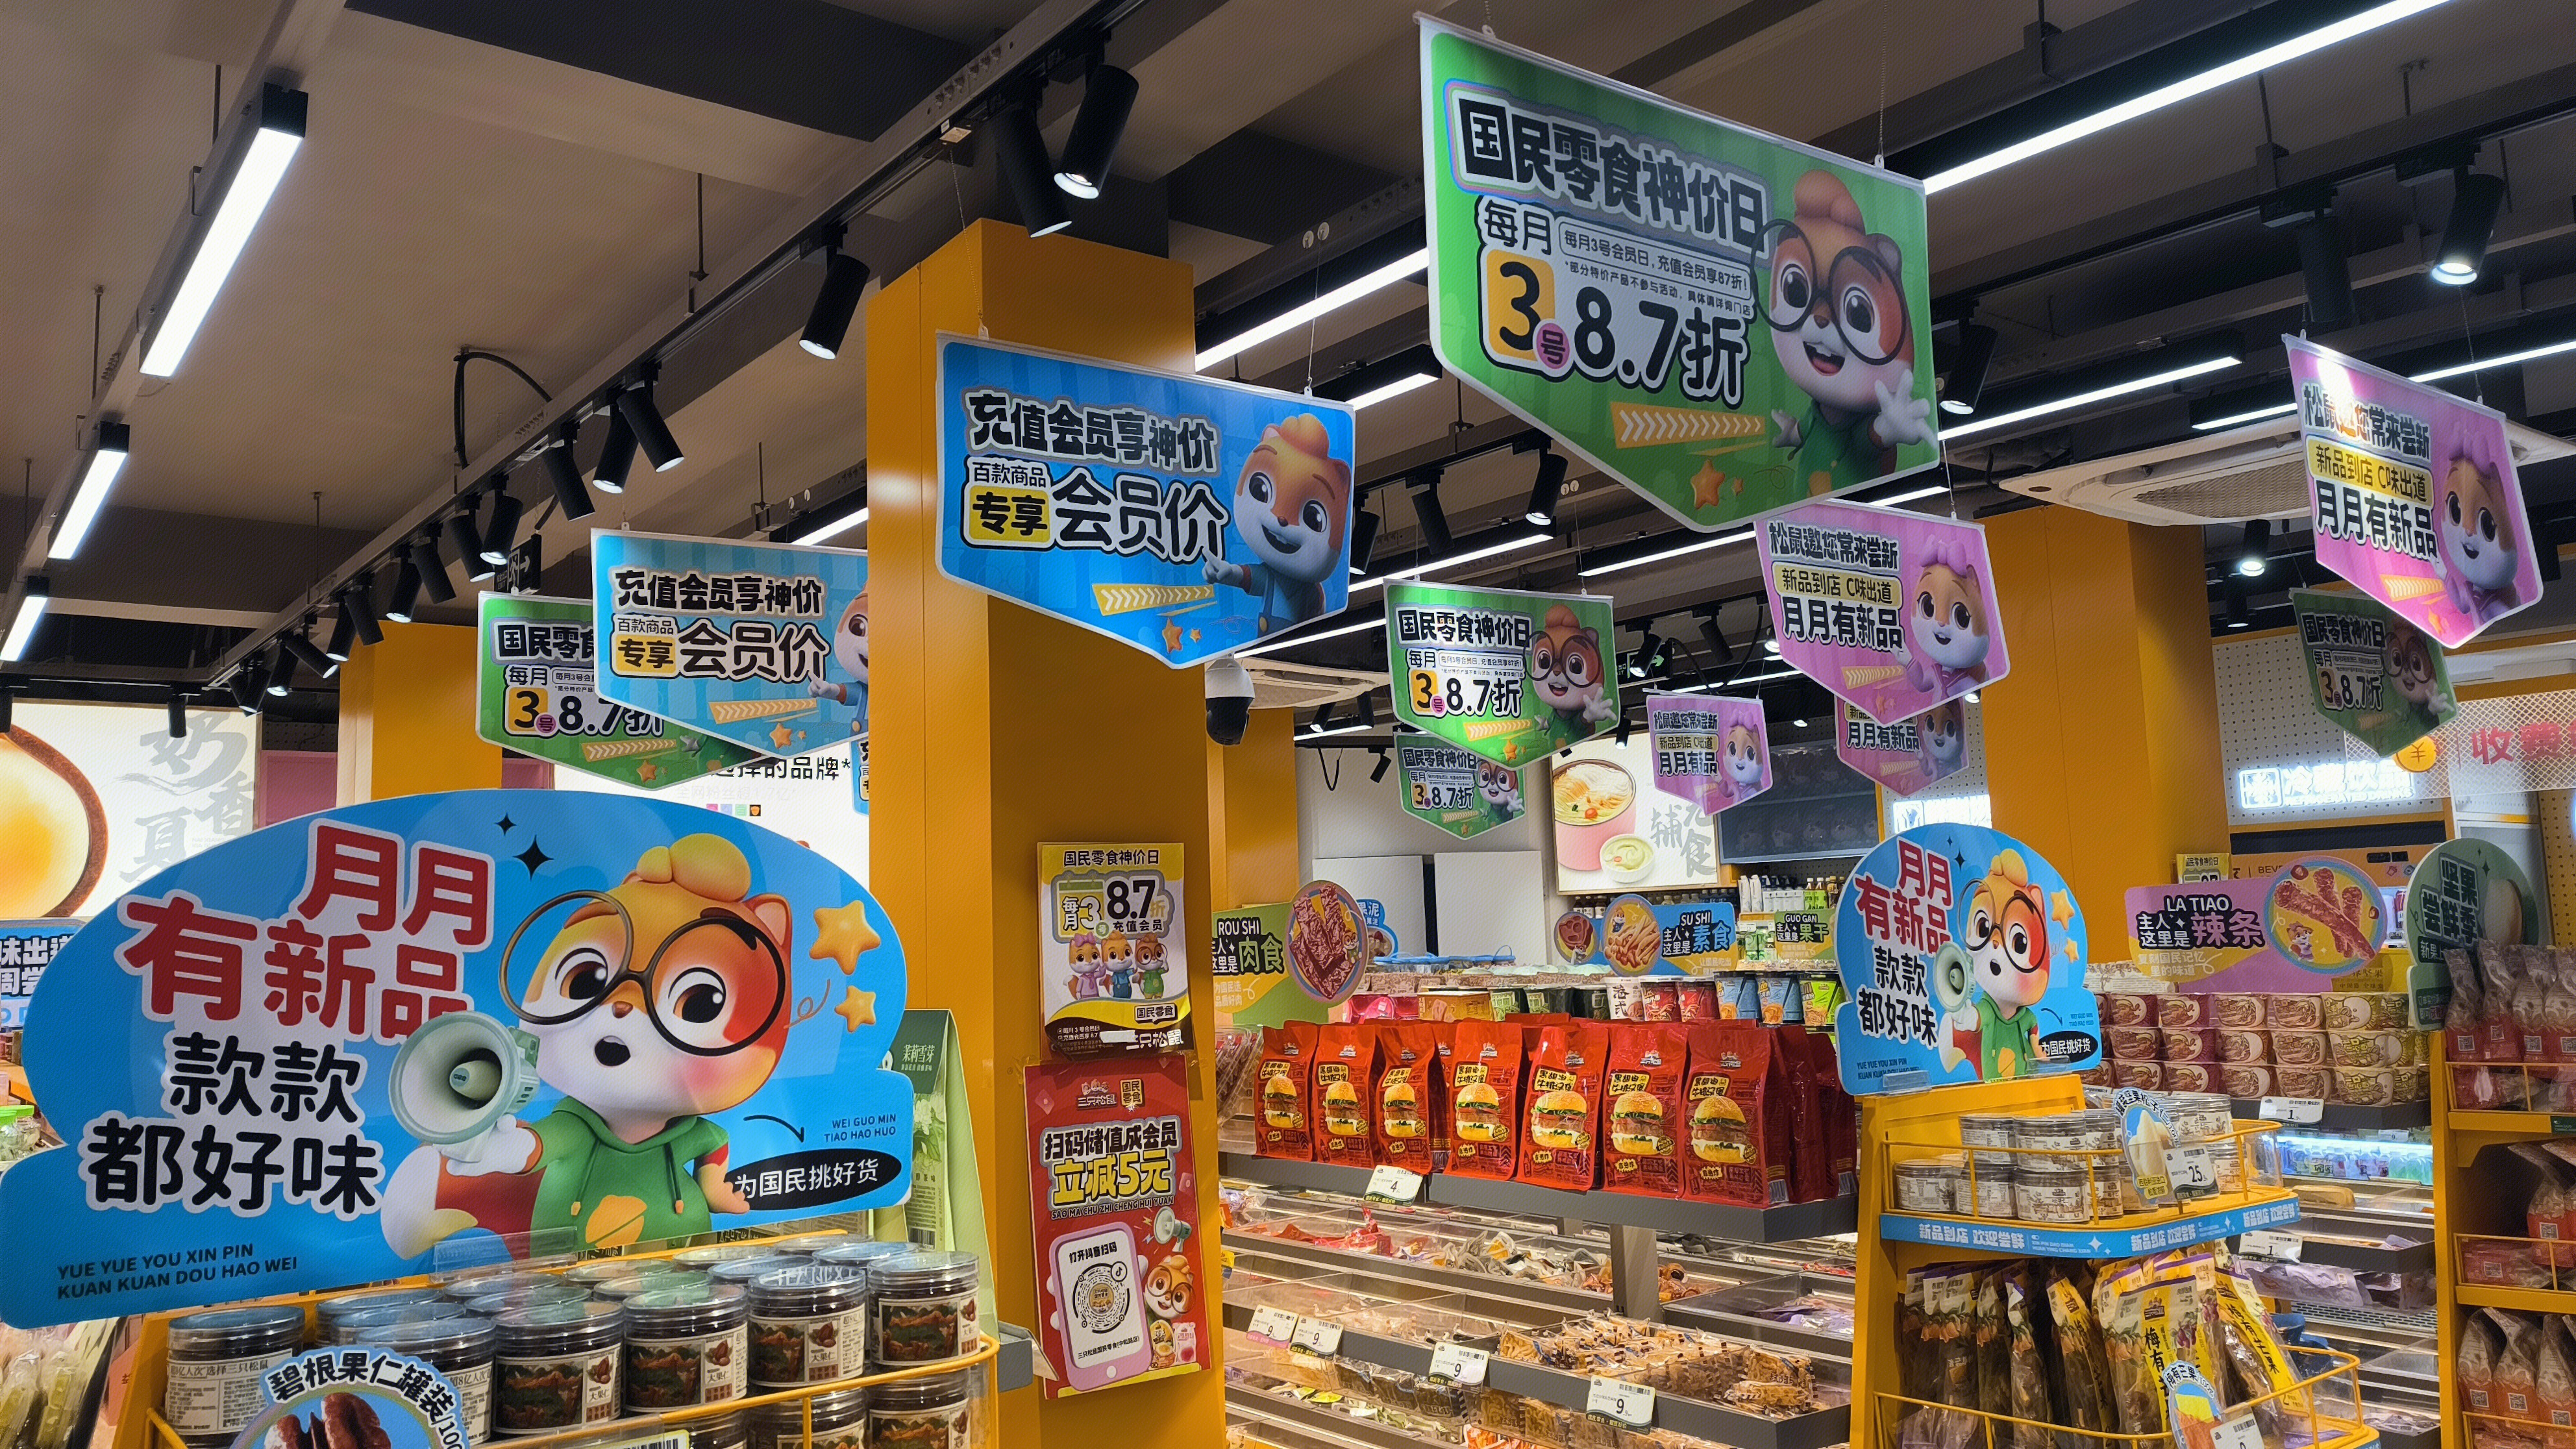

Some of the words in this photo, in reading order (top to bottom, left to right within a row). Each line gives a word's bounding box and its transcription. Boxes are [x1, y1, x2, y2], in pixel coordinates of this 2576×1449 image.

[1457, 98, 1769, 256] 国民零食神价日
[1483, 200, 1552, 256] 每月
[1574, 286, 1745, 404] 8.7折
[970, 395, 1214, 469] 充值会员享神价
[972, 462, 1046, 488] 百款商品
[2316, 445, 2373, 488] 新品到店
[2377, 465, 2427, 502] C味出道
[972, 492, 1047, 536] 专享
[1052, 472, 1229, 560] 会员价
[2316, 480, 2437, 559] 月月有新品
[1770, 523, 1898, 569] 松鼠邀您常来尝新
[615, 570, 821, 615] 充值会员享神价
[1782, 569, 1841, 597] 新品到店
[1847, 578, 1892, 604] C味出道
[617, 619, 674, 635] 百款商品
[1398, 610, 1531, 649] 国民零食神价日
[1782, 597, 1903, 649] 月月有新品
[2302, 615, 2386, 648] 国民零食神价日
[617, 638, 674, 669] 专享
[678, 623, 828, 680] 会员价
[1409, 650, 1436, 668] 每月
[2314, 650, 2332, 667] 每月
[509, 666, 547, 686] 每月
[1447, 678, 1520, 715] 8.7折
[1659, 736, 1692, 749] 新品到店
[1848, 722, 1920, 750] 月月有新品
[1403, 749, 1477, 770] 国民零食神价日
[1411, 772, 1426, 782] 每月
[1432, 786, 1472, 808] 8.7折
[1064, 850, 1159, 866] 国民零食神价日
[1898, 840, 1953, 906] 月月
[297, 825, 491, 946] 月月
[2441, 857, 2479, 909] 坚果
[1062, 896, 1078, 930] 每月
[1680, 915, 1693, 926] SU
[1697, 912, 1711, 924] SHI
[1785, 914, 1800, 923] GUO
[1855, 875, 1951, 955] 有新品
[2166, 897, 2188, 913] LA
[2190, 897, 2229, 911] TIAO
[1113, 919, 1163, 932] 充值会员
[1218, 921, 1239, 935] ROU
[1241, 919, 1259, 935] SHI
[1663, 928, 1681, 942] 主人
[1777, 923, 1791, 932] 主人
[1800, 923, 1829, 941] 果干
[2138, 913, 2171, 930] 主人
[2191, 912, 2264, 947] 辣条
[1663, 941, 1691, 956] 这里是
[1692, 922, 1731, 953] 素食
[2140, 930, 2191, 948] 这里是
[124, 897, 469, 1040] 有新品
[1239, 935, 1283, 972] 肉食
[2138, 951, 2206, 965] 复刻国民记忆
[1874, 946, 1927, 998] 款款
[2150, 963, 2196, 976] 里的味道
[1137, 1006, 1174, 1018] 国民零食
[1859, 987, 1938, 1047] 都好味
[2042, 1039, 2091, 1056] 为国民挑好货
[170, 1033, 362, 1123] 款款
[824, 1132, 848, 1143] TIAO
[850, 1129, 872, 1141] HAO
[874, 1126, 897, 1137] HUO
[832, 1117, 851, 1130] WEI
[853, 1115, 876, 1128] GUO
[878, 1113, 897, 1126] MIN
[1044, 1121, 1178, 1161] 扫码储值成会员
[88, 1118, 379, 1213] 都好味
[734, 1158, 879, 1200] 为国民挑好货
[1053, 1150, 1171, 1205] 立减5元
[1052, 1210, 1067, 1219] SAO
[1069, 1208, 1082, 1218] MA
[1082, 1206, 1098, 1216] CHU
[1100, 1204, 1112, 1213] ZHI
[1113, 1201, 1138, 1211] CHENG
[1139, 1198, 1152, 1209] HUI
[1153, 1196, 1174, 1206] YUAN
[1918, 1223, 1969, 1244] 新品到店
[1973, 1229, 2025, 1250] 欢迎尝鲜
[2131, 1230, 2166, 1252] 新品到店
[57, 1262, 96, 1281] YUE
[101, 1256, 138, 1276] YUE
[142, 1251, 182, 1270] YOU
[187, 1246, 218, 1265] XIN
[222, 1243, 254, 1261] PIN
[1069, 1242, 1117, 1264] 打开抖音扫码
[57, 1279, 112, 1299] KUAN
[118, 1274, 170, 1293] KUAN
[175, 1268, 216, 1285] DOU
[221, 1262, 260, 1279] HAO
[265, 1256, 298, 1272] WEI
